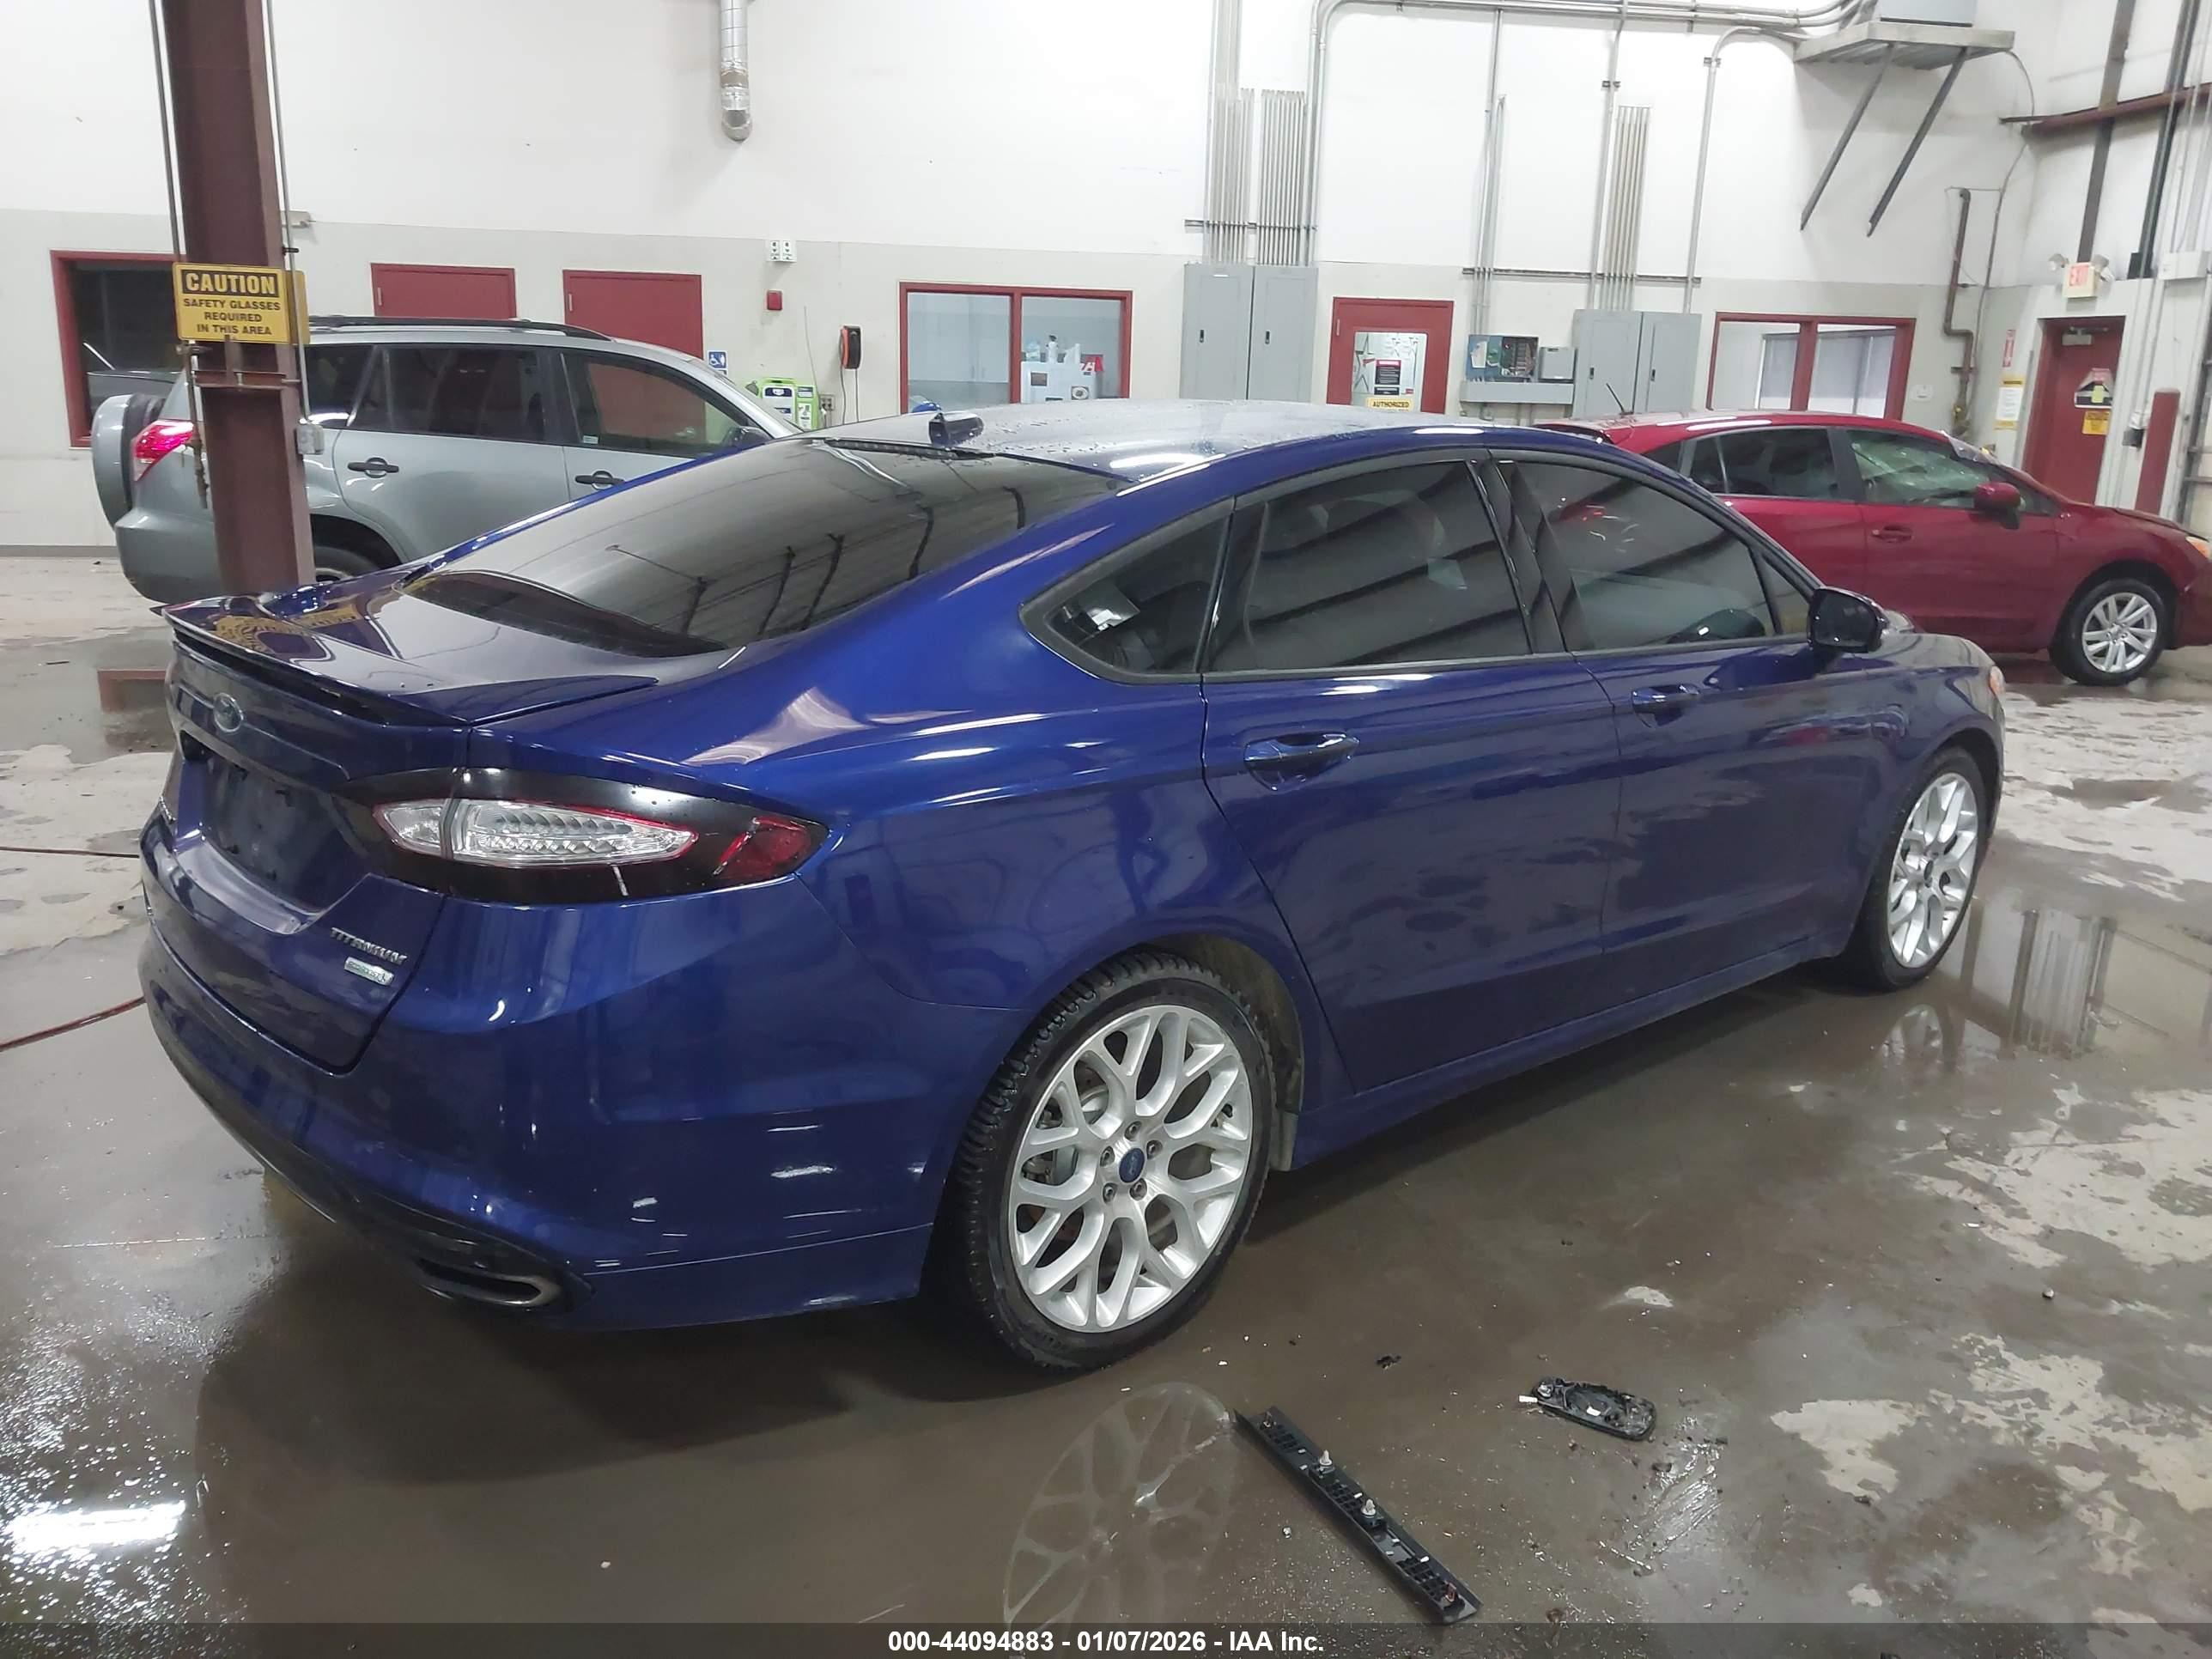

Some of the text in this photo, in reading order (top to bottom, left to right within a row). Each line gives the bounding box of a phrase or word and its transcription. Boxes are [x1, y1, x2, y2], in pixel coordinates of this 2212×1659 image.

[185, 272, 275, 294] CAUTION
[183, 298, 282, 311] SAFETY GLASSES
[204, 312, 263, 322] REQUIRED
[197, 324, 272, 335] IN THIS AREA
[330, 927, 408, 965] TITANIUM
